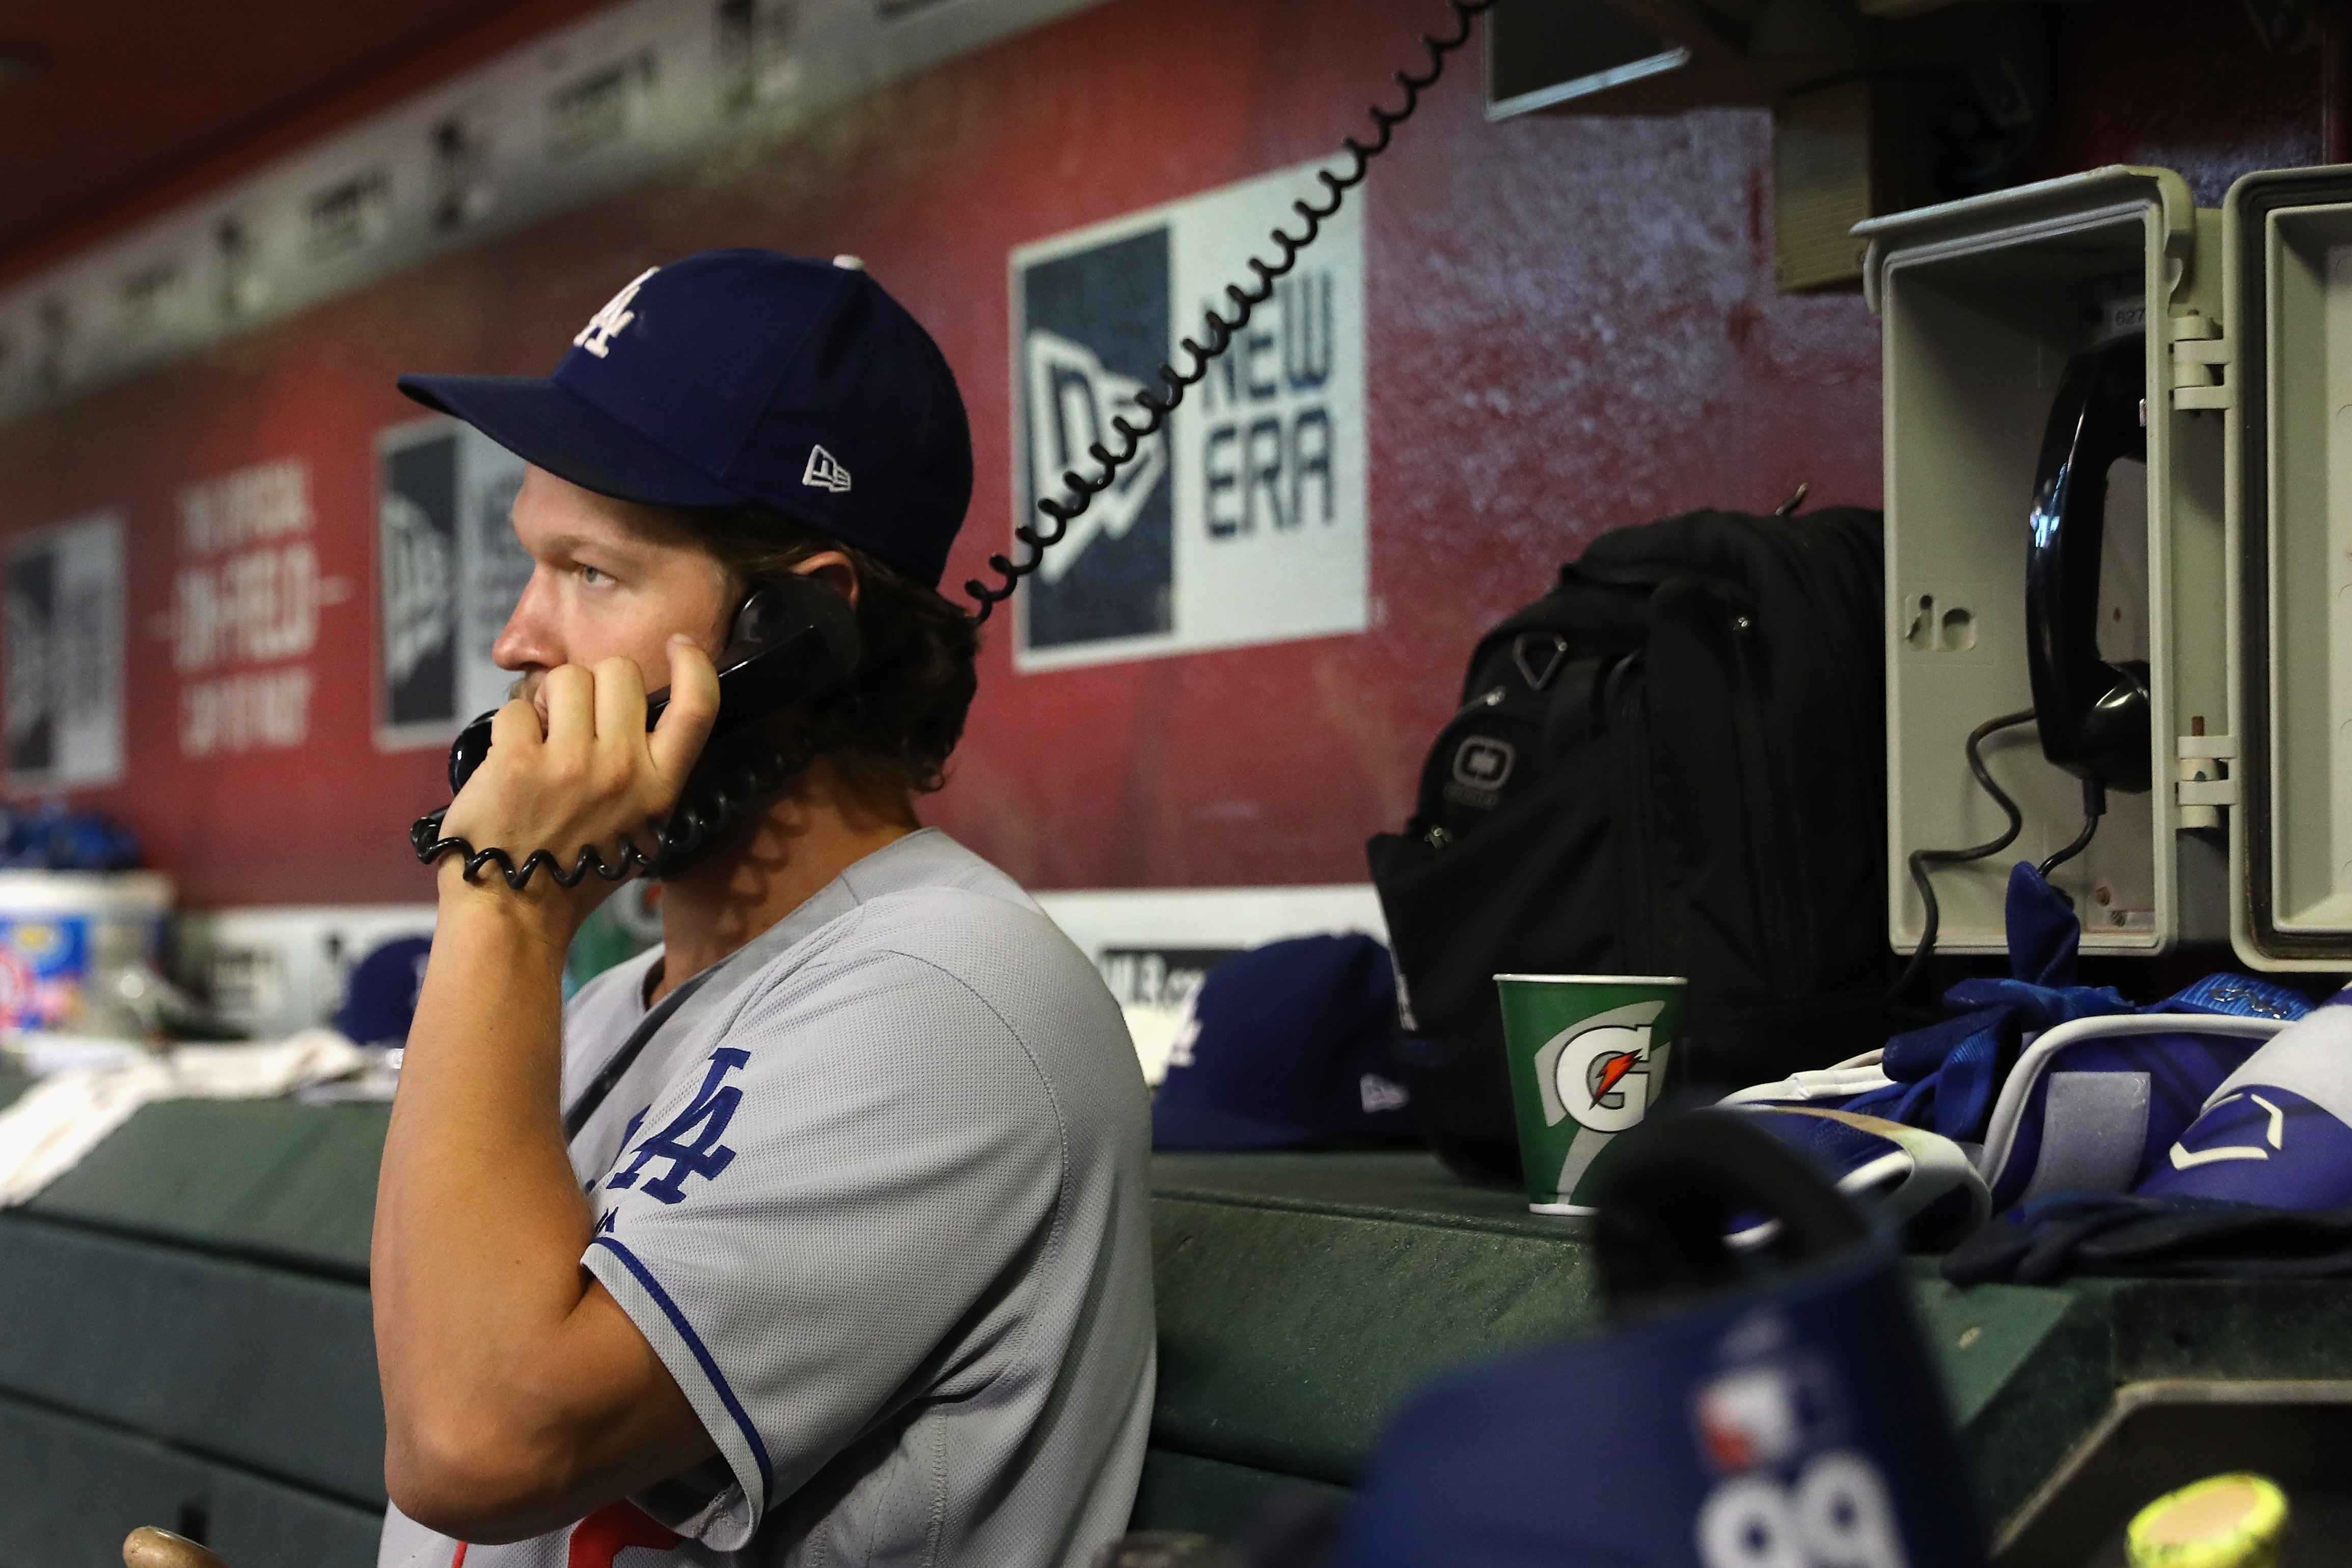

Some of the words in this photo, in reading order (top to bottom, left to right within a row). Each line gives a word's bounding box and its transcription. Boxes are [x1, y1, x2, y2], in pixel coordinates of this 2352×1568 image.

[1202, 271, 1332, 414] NEW
[1203, 408, 1333, 539] ERA
[606, 1048, 751, 1205] LA
[1555, 1024, 1652, 1134] G
